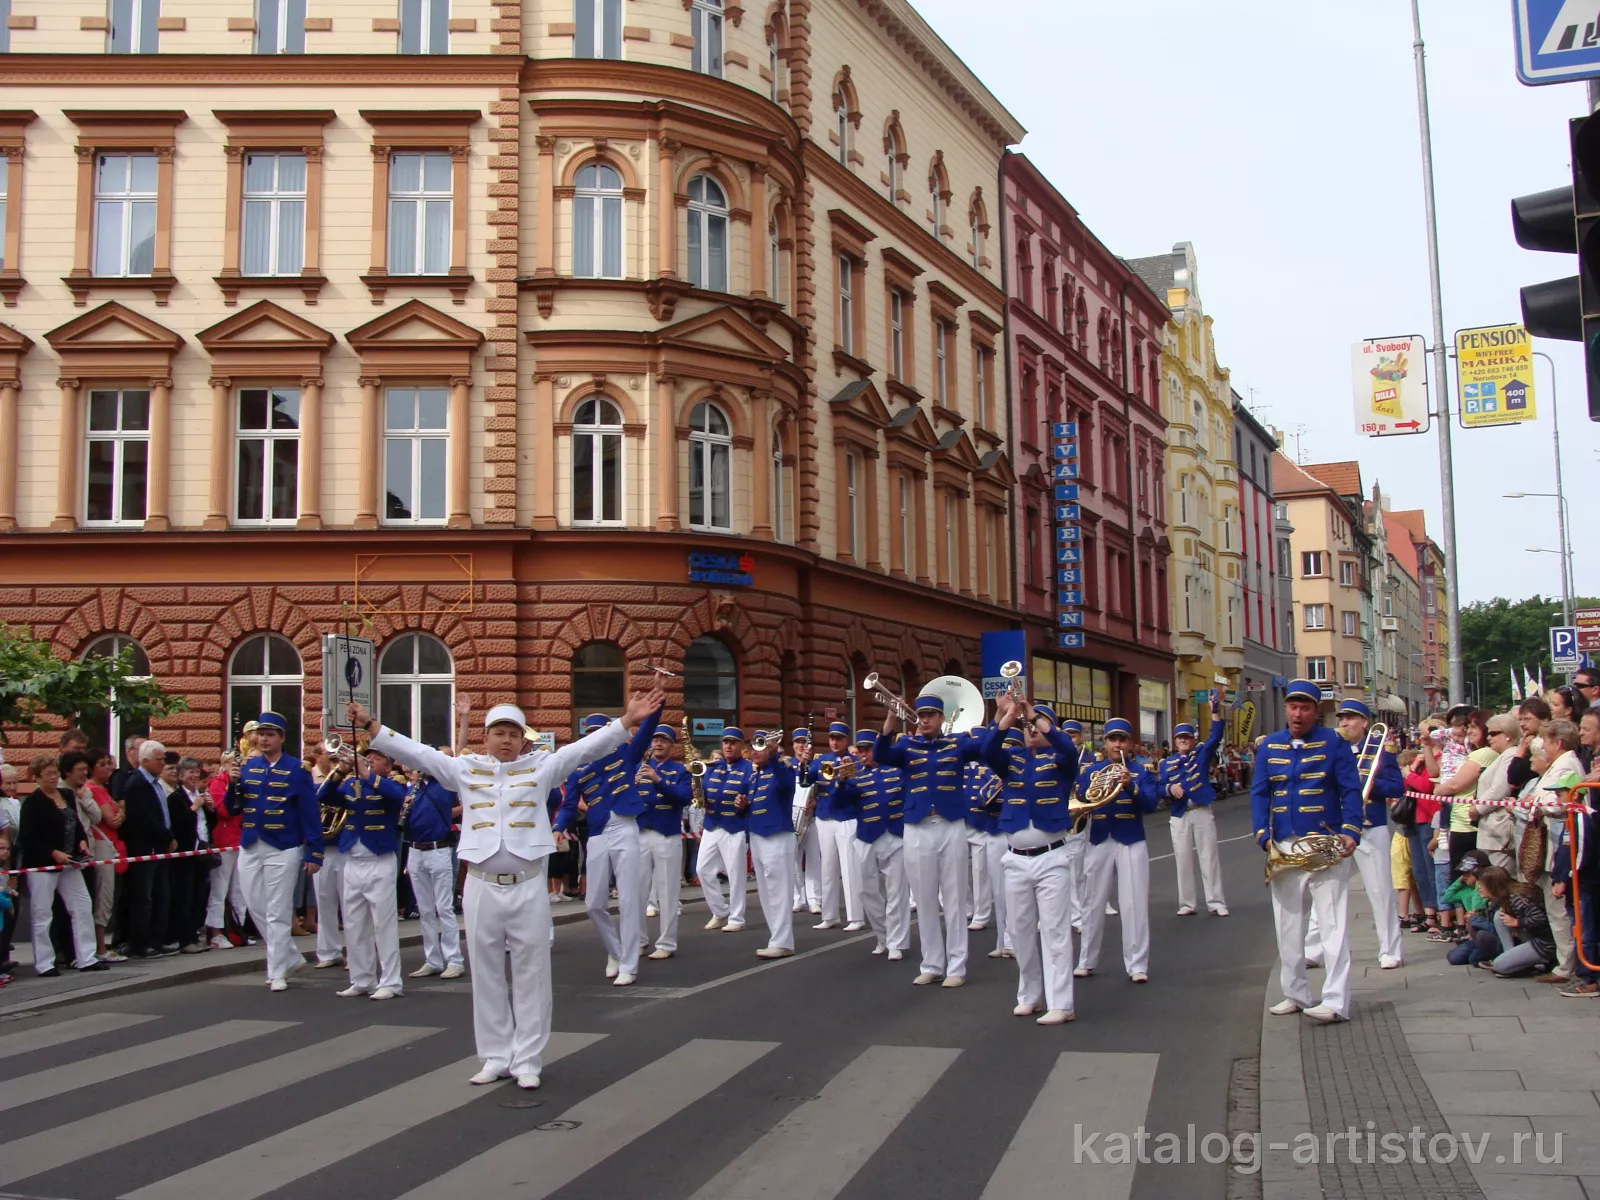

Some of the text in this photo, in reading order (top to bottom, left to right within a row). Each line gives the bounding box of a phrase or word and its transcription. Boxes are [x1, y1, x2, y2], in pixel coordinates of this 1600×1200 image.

[1363, 342, 1411, 353] ul. Svobody
[1461, 328, 1527, 350] PENSION
[1462, 355, 1528, 368] MARIKA
[1375, 389, 1396, 401] BILLA
[1362, 423, 1376, 432] 150
[1057, 424, 1080, 646] IVA LEASING
[1556, 631, 1572, 653] P
[1240, 706, 1254, 736] Nikon
